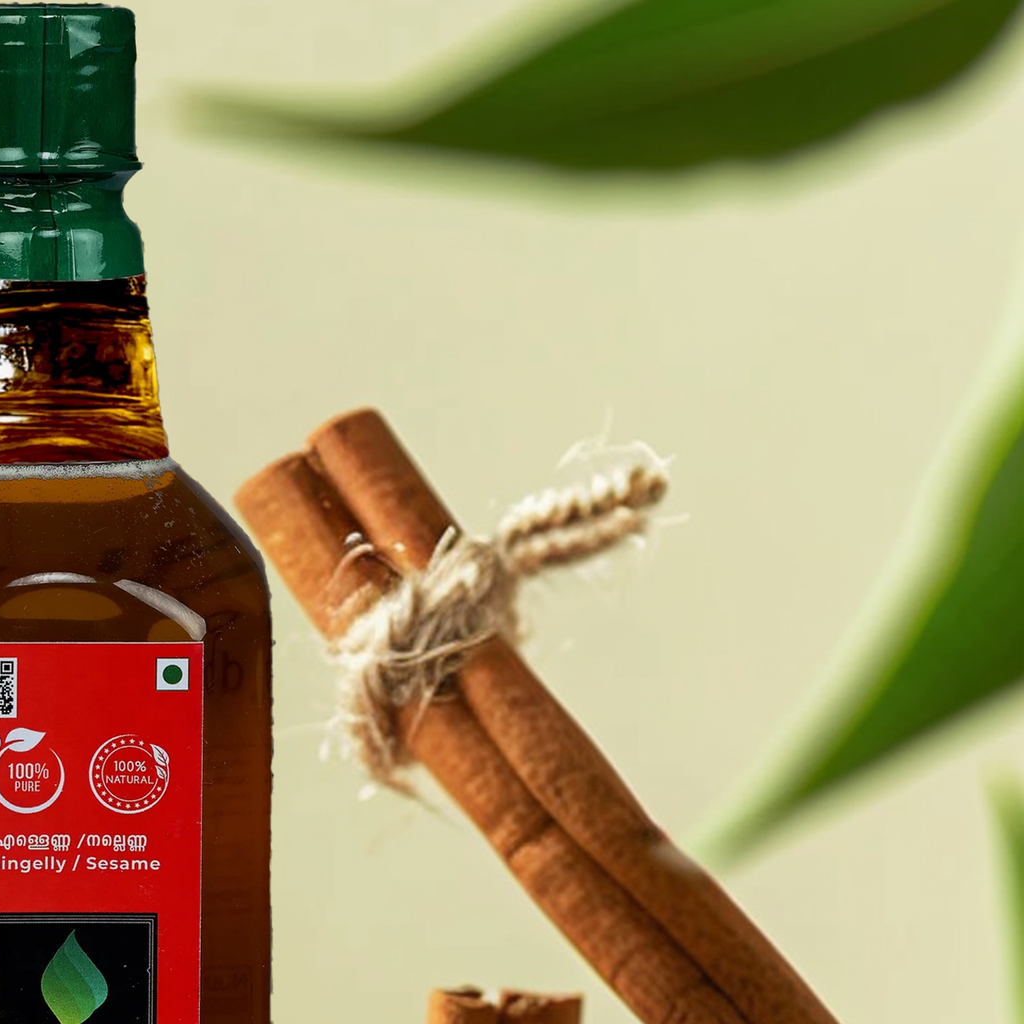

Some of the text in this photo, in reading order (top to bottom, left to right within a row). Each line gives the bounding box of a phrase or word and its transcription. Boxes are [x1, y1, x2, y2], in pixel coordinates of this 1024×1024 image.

[8, 763, 49, 779] 100%
[114, 760, 147, 773] 100%
[14, 781, 40, 792] PURE
[105, 775, 154, 785] NATURAL
[86, 856, 161, 870] Sesame
